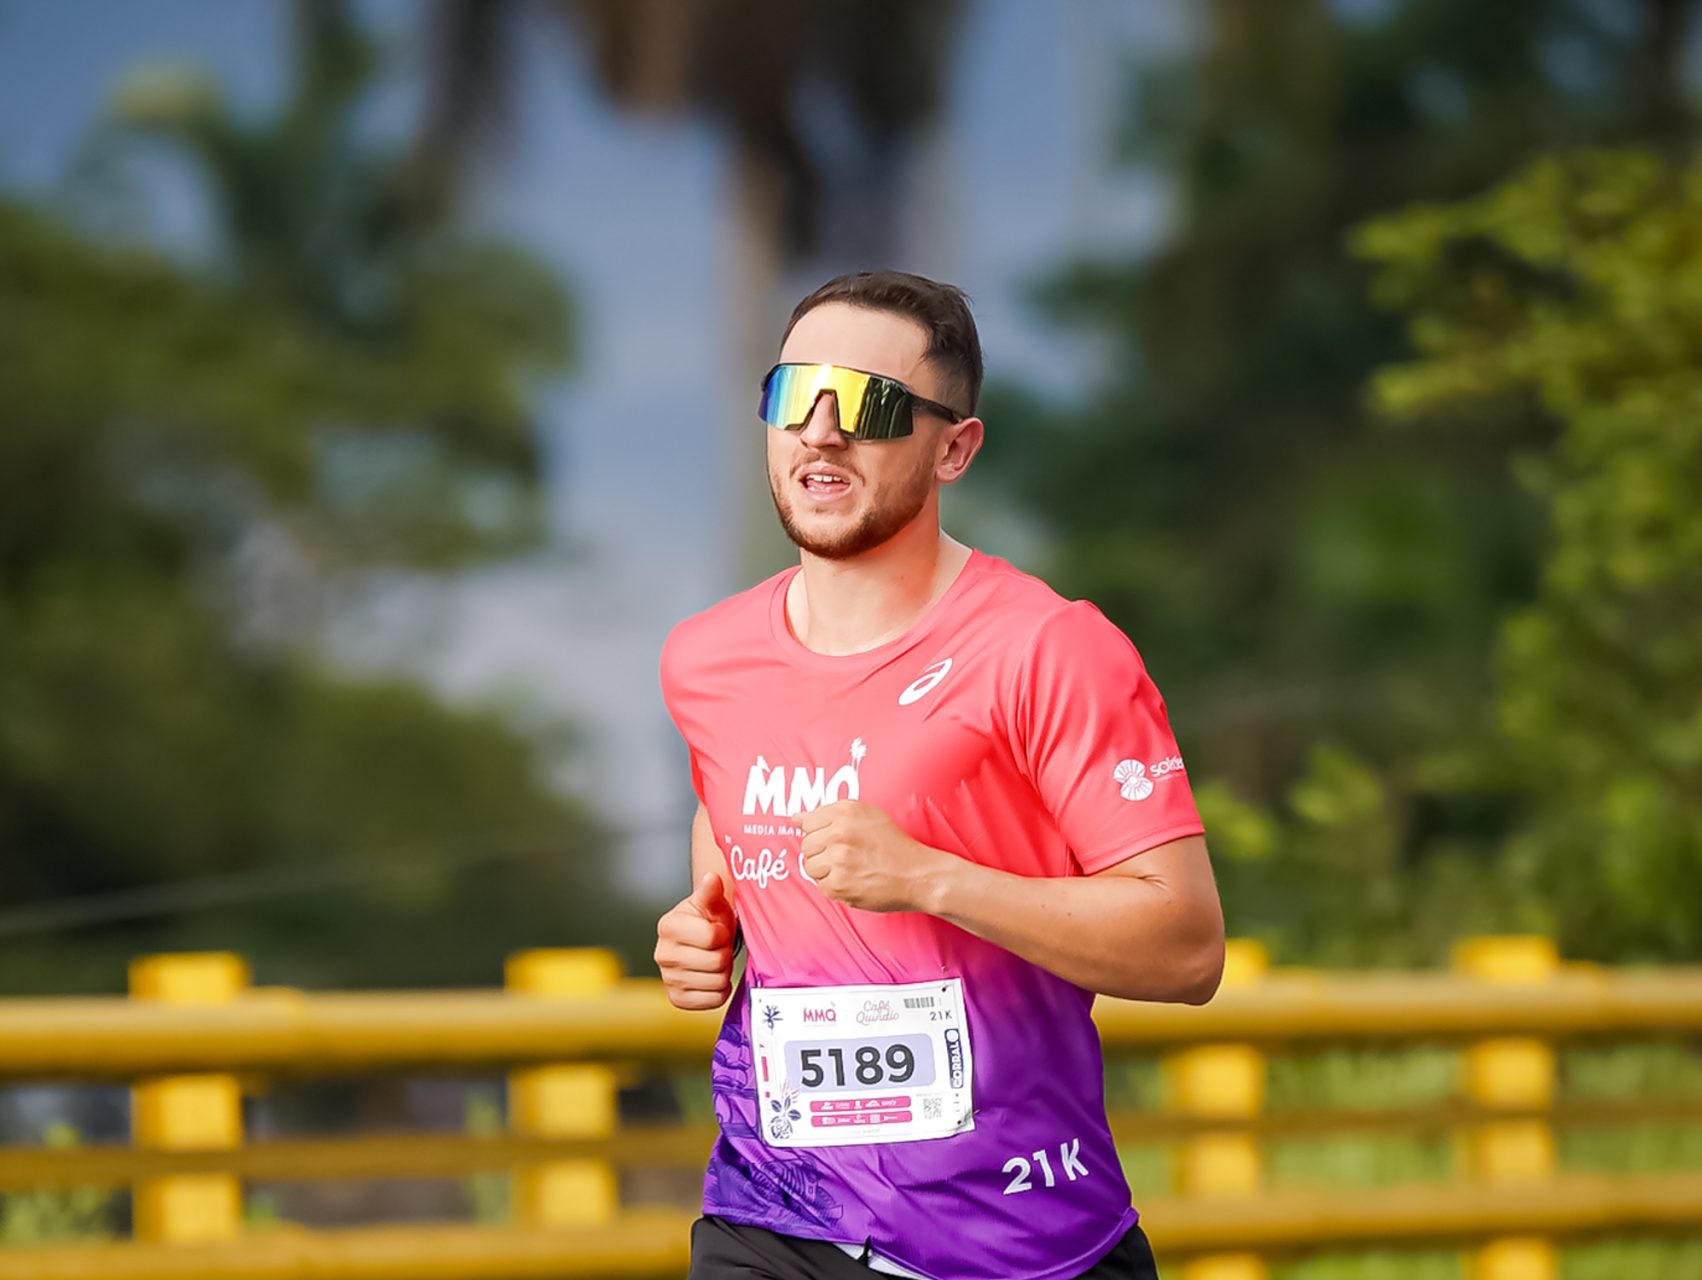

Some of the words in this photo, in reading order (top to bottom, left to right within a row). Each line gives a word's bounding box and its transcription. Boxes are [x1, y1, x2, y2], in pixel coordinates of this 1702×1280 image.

[743, 824, 775, 836] MEDIA
[731, 845, 790, 889] Café
[803, 1006, 836, 1022] MMQ
[863, 1000, 890, 1014] Café
[800, 1044, 915, 1088] 5189
[950, 1041, 963, 1088] CORRAL
